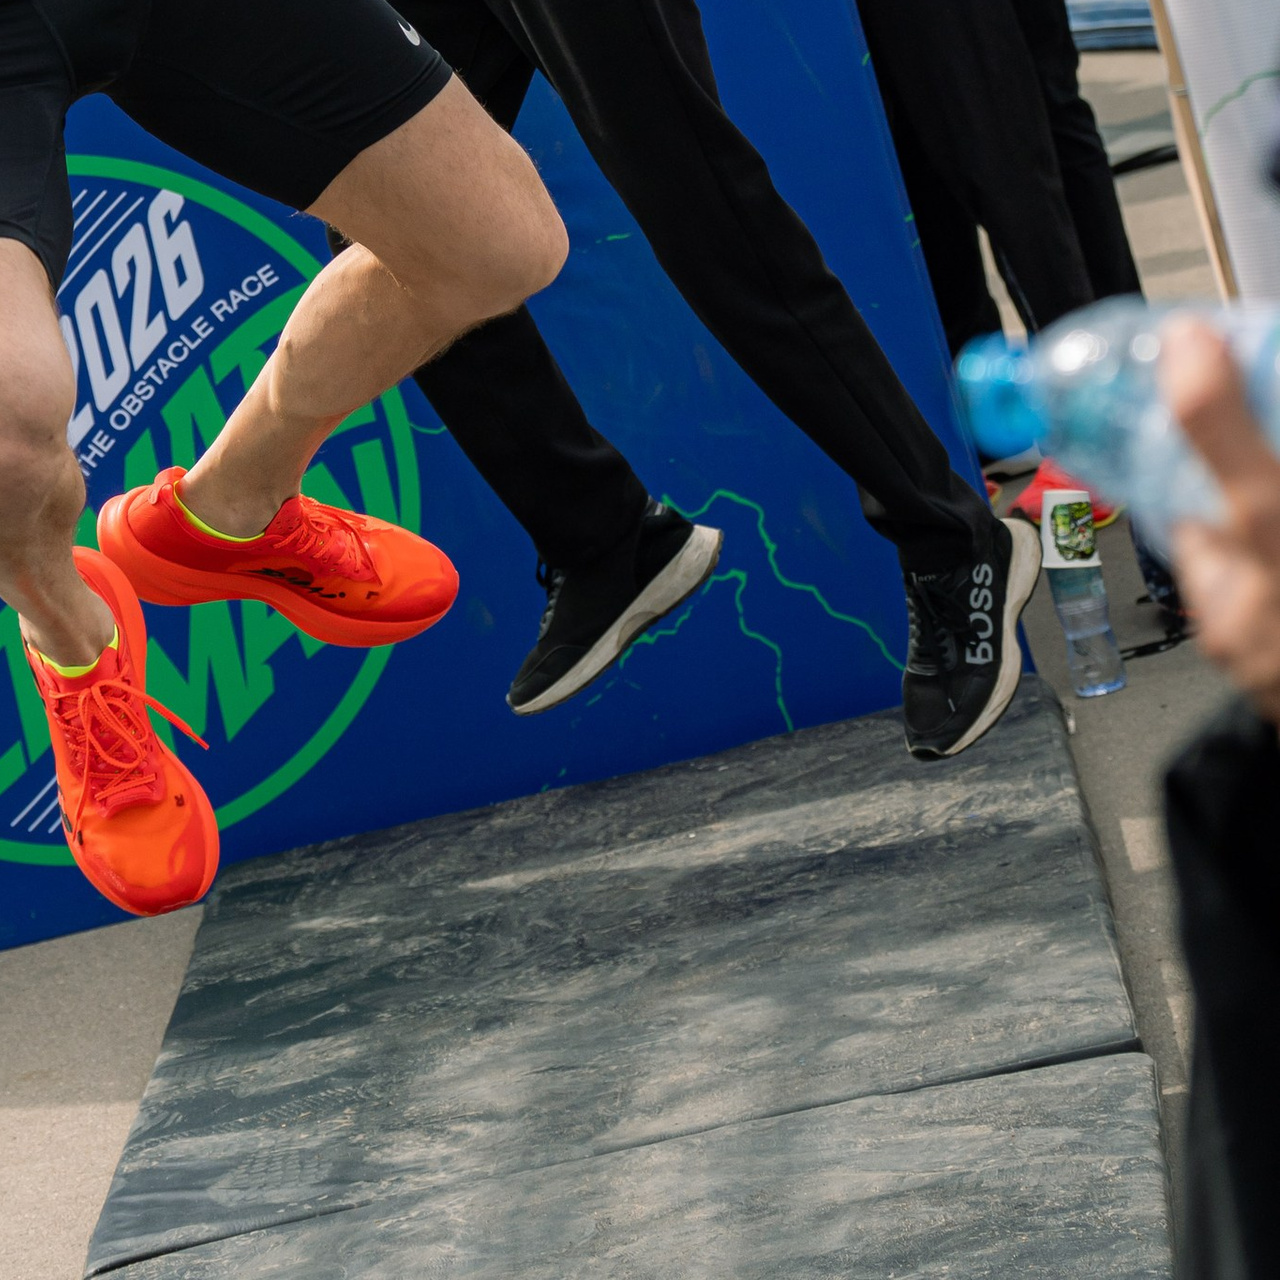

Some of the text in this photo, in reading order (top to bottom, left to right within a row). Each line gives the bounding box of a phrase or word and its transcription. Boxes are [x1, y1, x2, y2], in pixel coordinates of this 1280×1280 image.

[109, 316, 215, 431] OBSTACLE
[210, 263, 280, 322] RACE
[965, 562, 995, 666] BOSS
